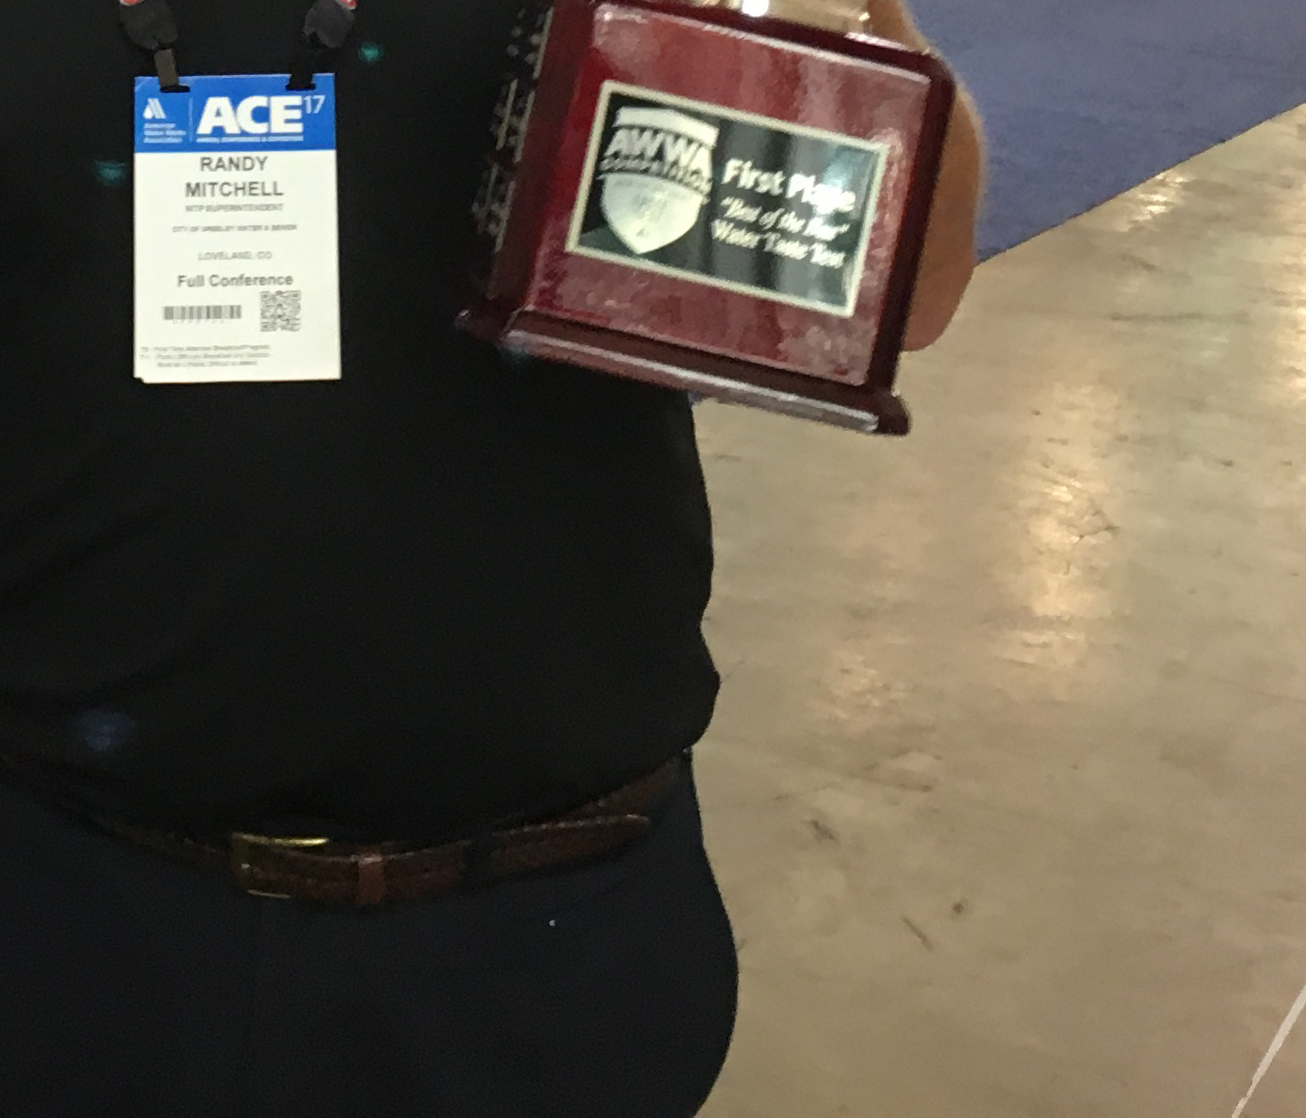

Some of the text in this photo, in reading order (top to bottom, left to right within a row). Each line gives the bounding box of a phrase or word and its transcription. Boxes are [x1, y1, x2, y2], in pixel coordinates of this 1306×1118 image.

[196, 95, 305, 135] ACE
[199, 155, 269, 172] RANDY
[722, 157, 786, 197] First
[184, 181, 286, 198] MITCHELL
[176, 273, 295, 288] Full Conference
